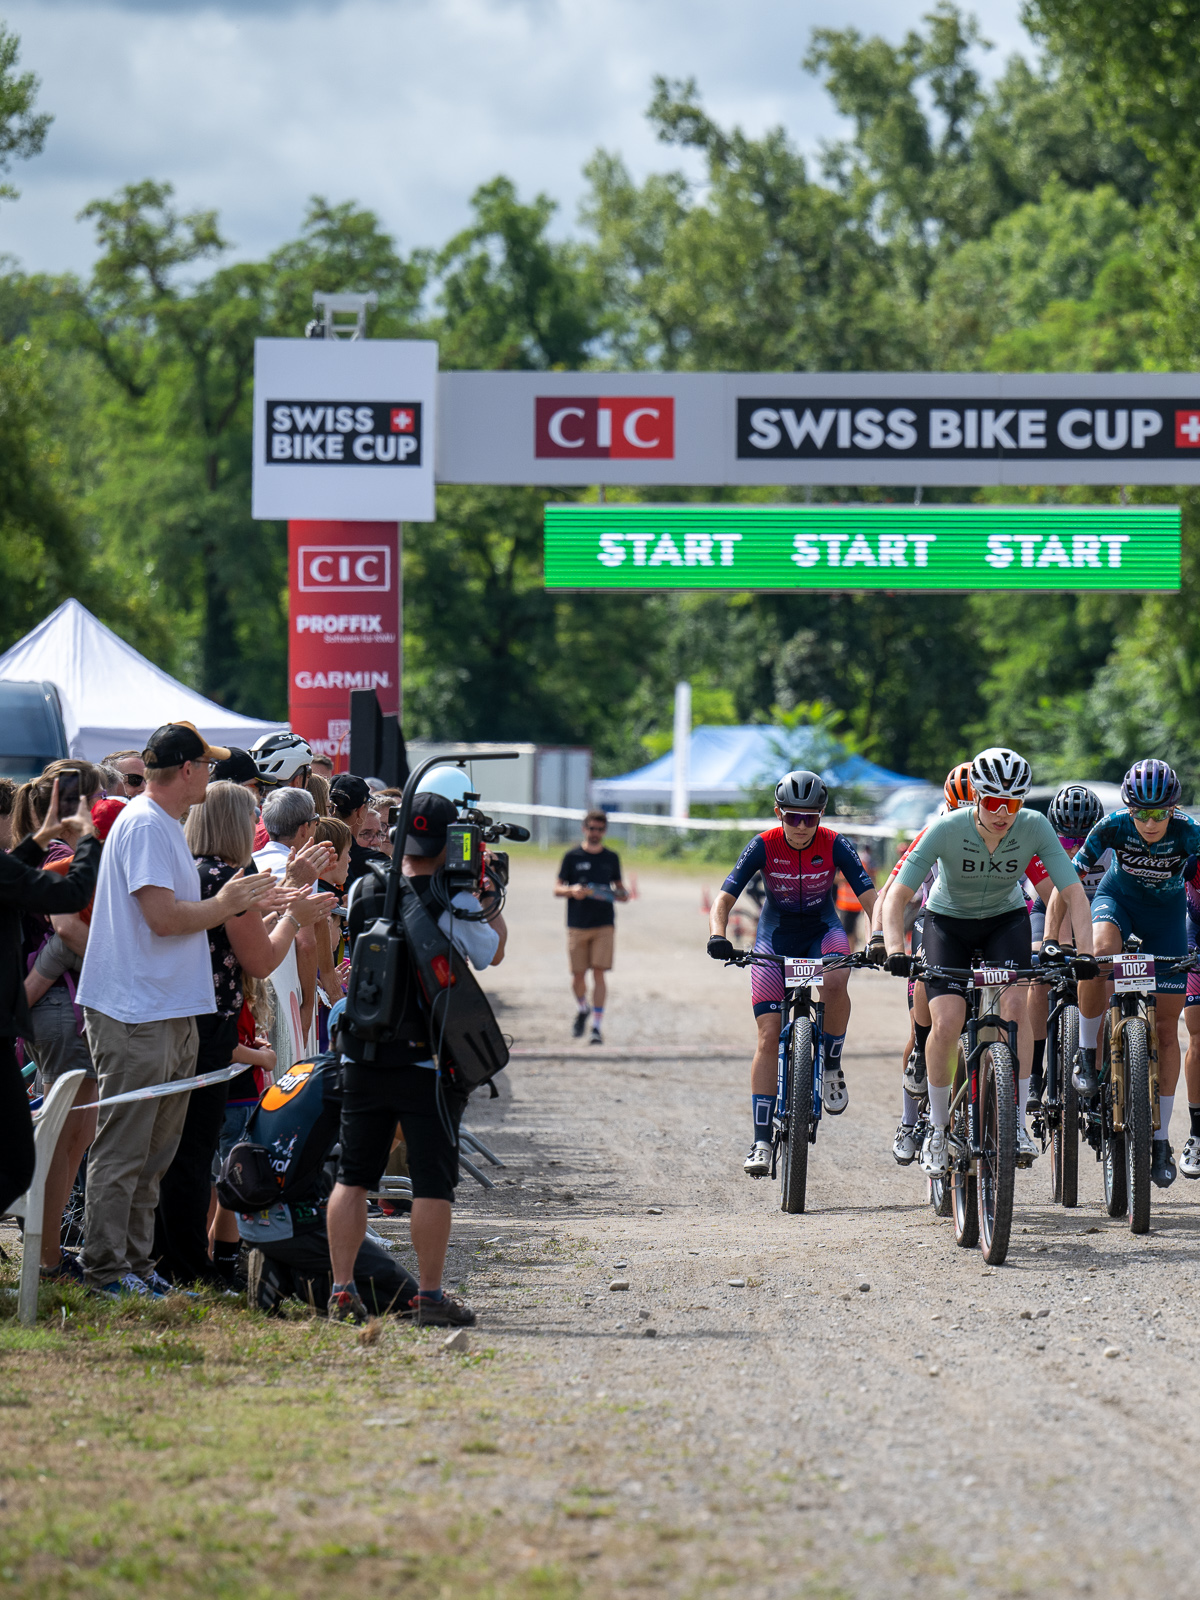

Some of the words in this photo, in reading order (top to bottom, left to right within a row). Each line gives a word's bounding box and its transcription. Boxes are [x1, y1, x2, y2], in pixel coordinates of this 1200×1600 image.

[271, 405, 375, 434] SWISS
[548, 407, 660, 449] CIC
[748, 407, 918, 450] SWISS
[928, 408, 1047, 449] BIKE
[1057, 408, 1164, 451] CUP
[271, 433, 345, 460] BIKE
[352, 434, 418, 462] CUP
[597, 533, 743, 567] START
[790, 533, 938, 568] START
[984, 534, 1131, 569] START
[309, 555, 379, 583] CIC
[296, 614, 382, 634] PROFFIX
[295, 670, 389, 689] GARMIN
[308, 739, 350, 756] WOR
[414, 816, 428, 831] Q
[962, 859, 1018, 873] BIXS
[1117, 849, 1181, 868] Wilier
[1133, 869, 1169, 879] vittoria
[792, 966, 816, 976] 1007
[981, 971, 1010, 985] 1004
[1121, 962, 1148, 977] 1002
